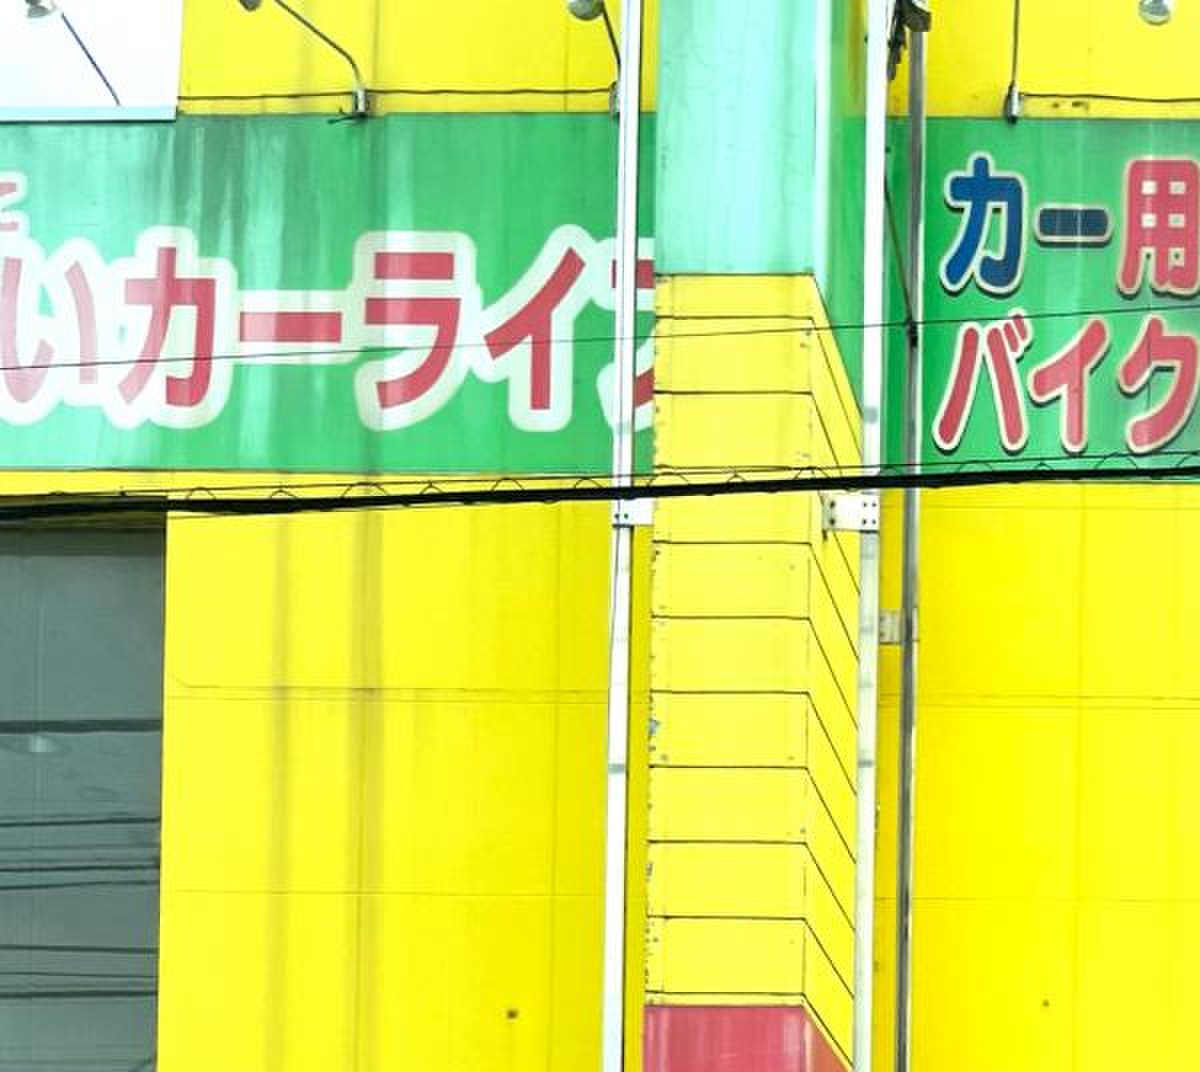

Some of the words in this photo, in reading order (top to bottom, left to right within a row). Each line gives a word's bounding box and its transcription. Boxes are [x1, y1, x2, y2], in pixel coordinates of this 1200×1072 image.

[0, 240, 655, 418] いカーライ
